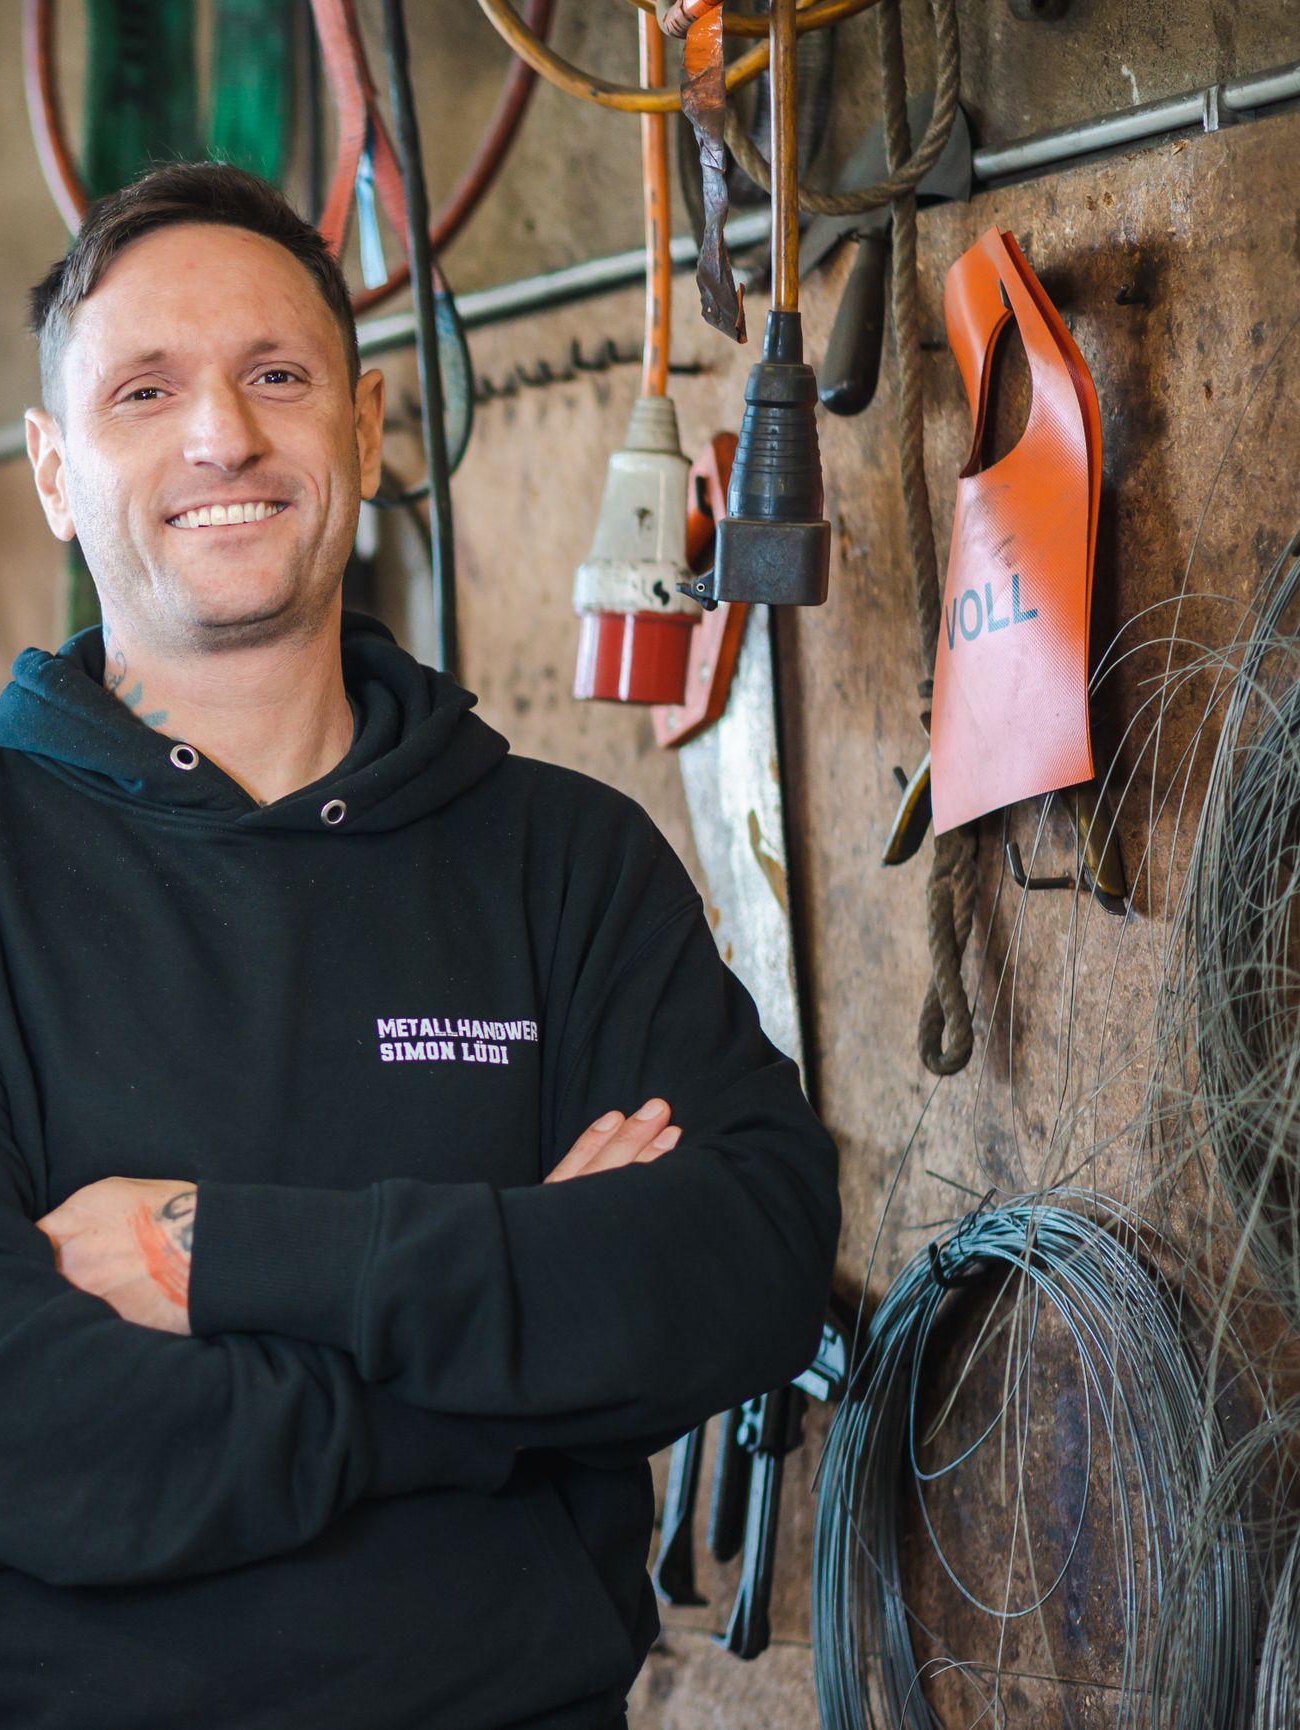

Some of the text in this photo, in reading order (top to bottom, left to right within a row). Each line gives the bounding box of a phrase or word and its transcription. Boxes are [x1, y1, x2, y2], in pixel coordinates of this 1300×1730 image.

[946, 573, 1038, 650] VOLL
[380, 1040, 509, 1064] SIMON LÜDI
